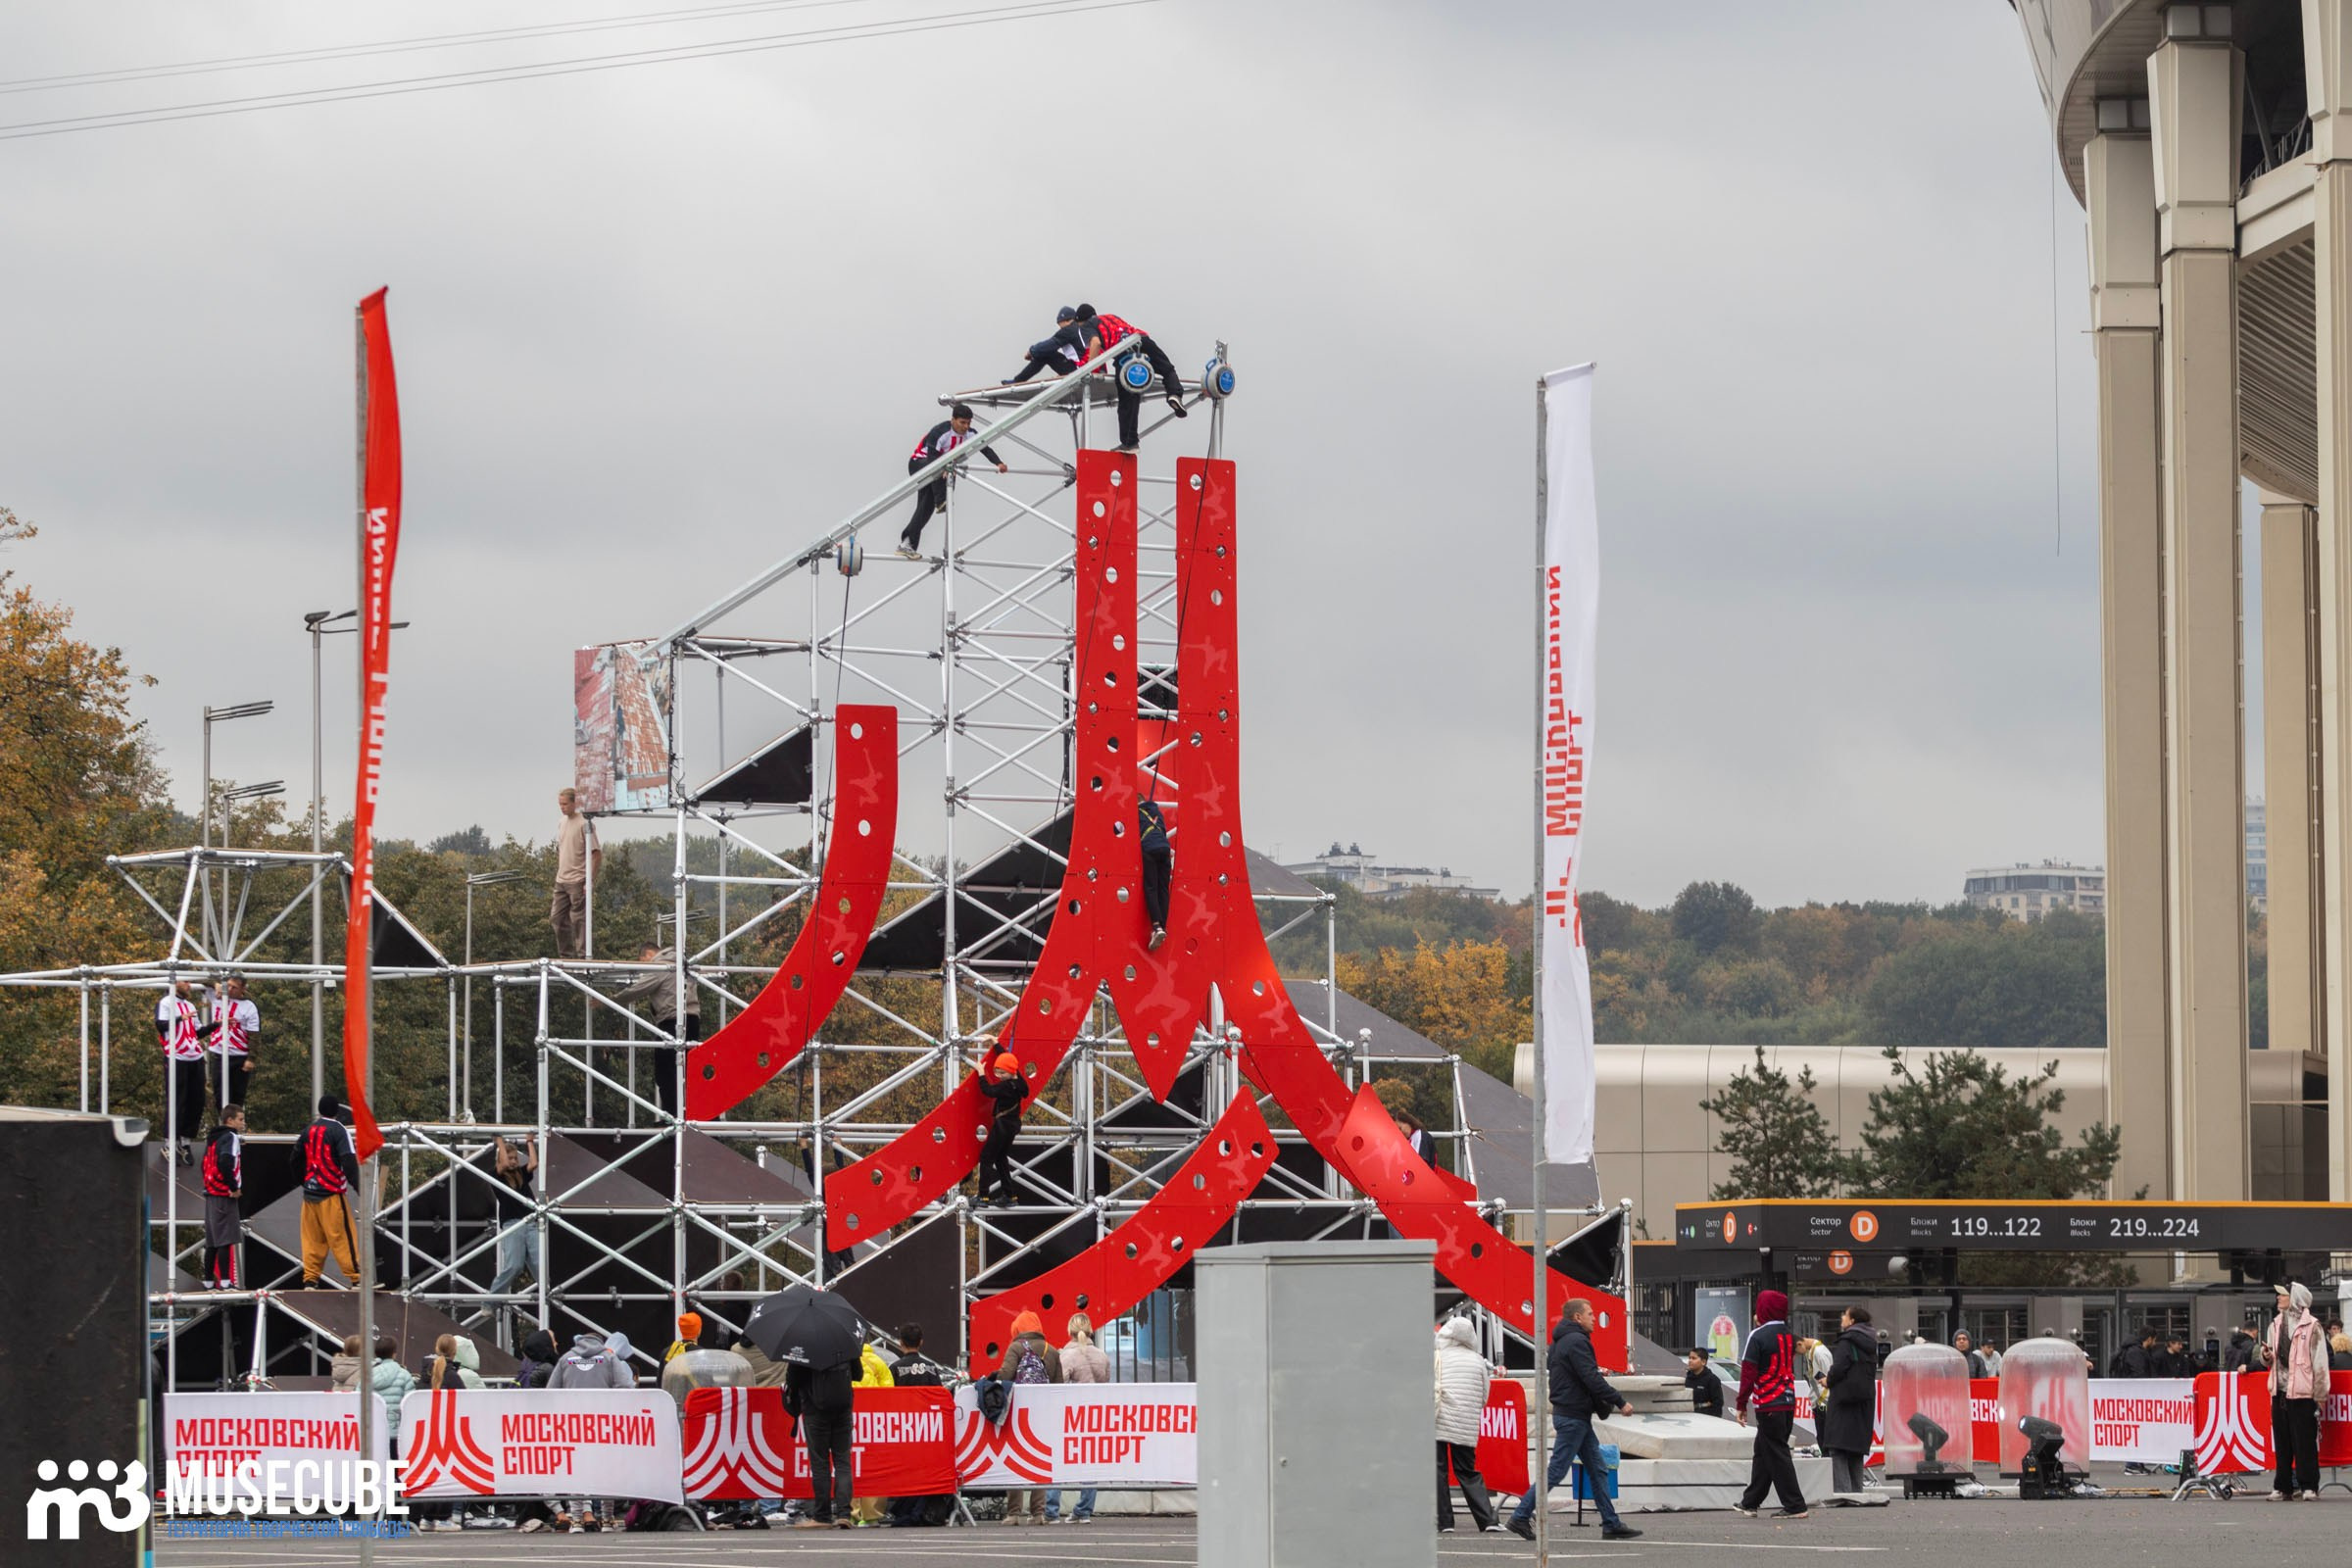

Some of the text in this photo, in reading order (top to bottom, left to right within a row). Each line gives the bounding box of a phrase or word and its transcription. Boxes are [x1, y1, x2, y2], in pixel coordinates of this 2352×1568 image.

[1810, 1216, 1874, 1236] Сектор D
[1911, 1217, 2041, 1237] Блоки 119...122
[2070, 1217, 2200, 1237] Блоки 219...224
[2093, 1395, 2192, 1425] МОСКОВСКИЙ
[175, 1414, 361, 1451] МОСКОВСКИЙ
[502, 1409, 656, 1446] МОСКОВСКИЙ
[2094, 1424, 2140, 1447] СПОРТ
[503, 1446, 575, 1475] СПОРТ
[1063, 1436, 1146, 1464] СПОРТ
